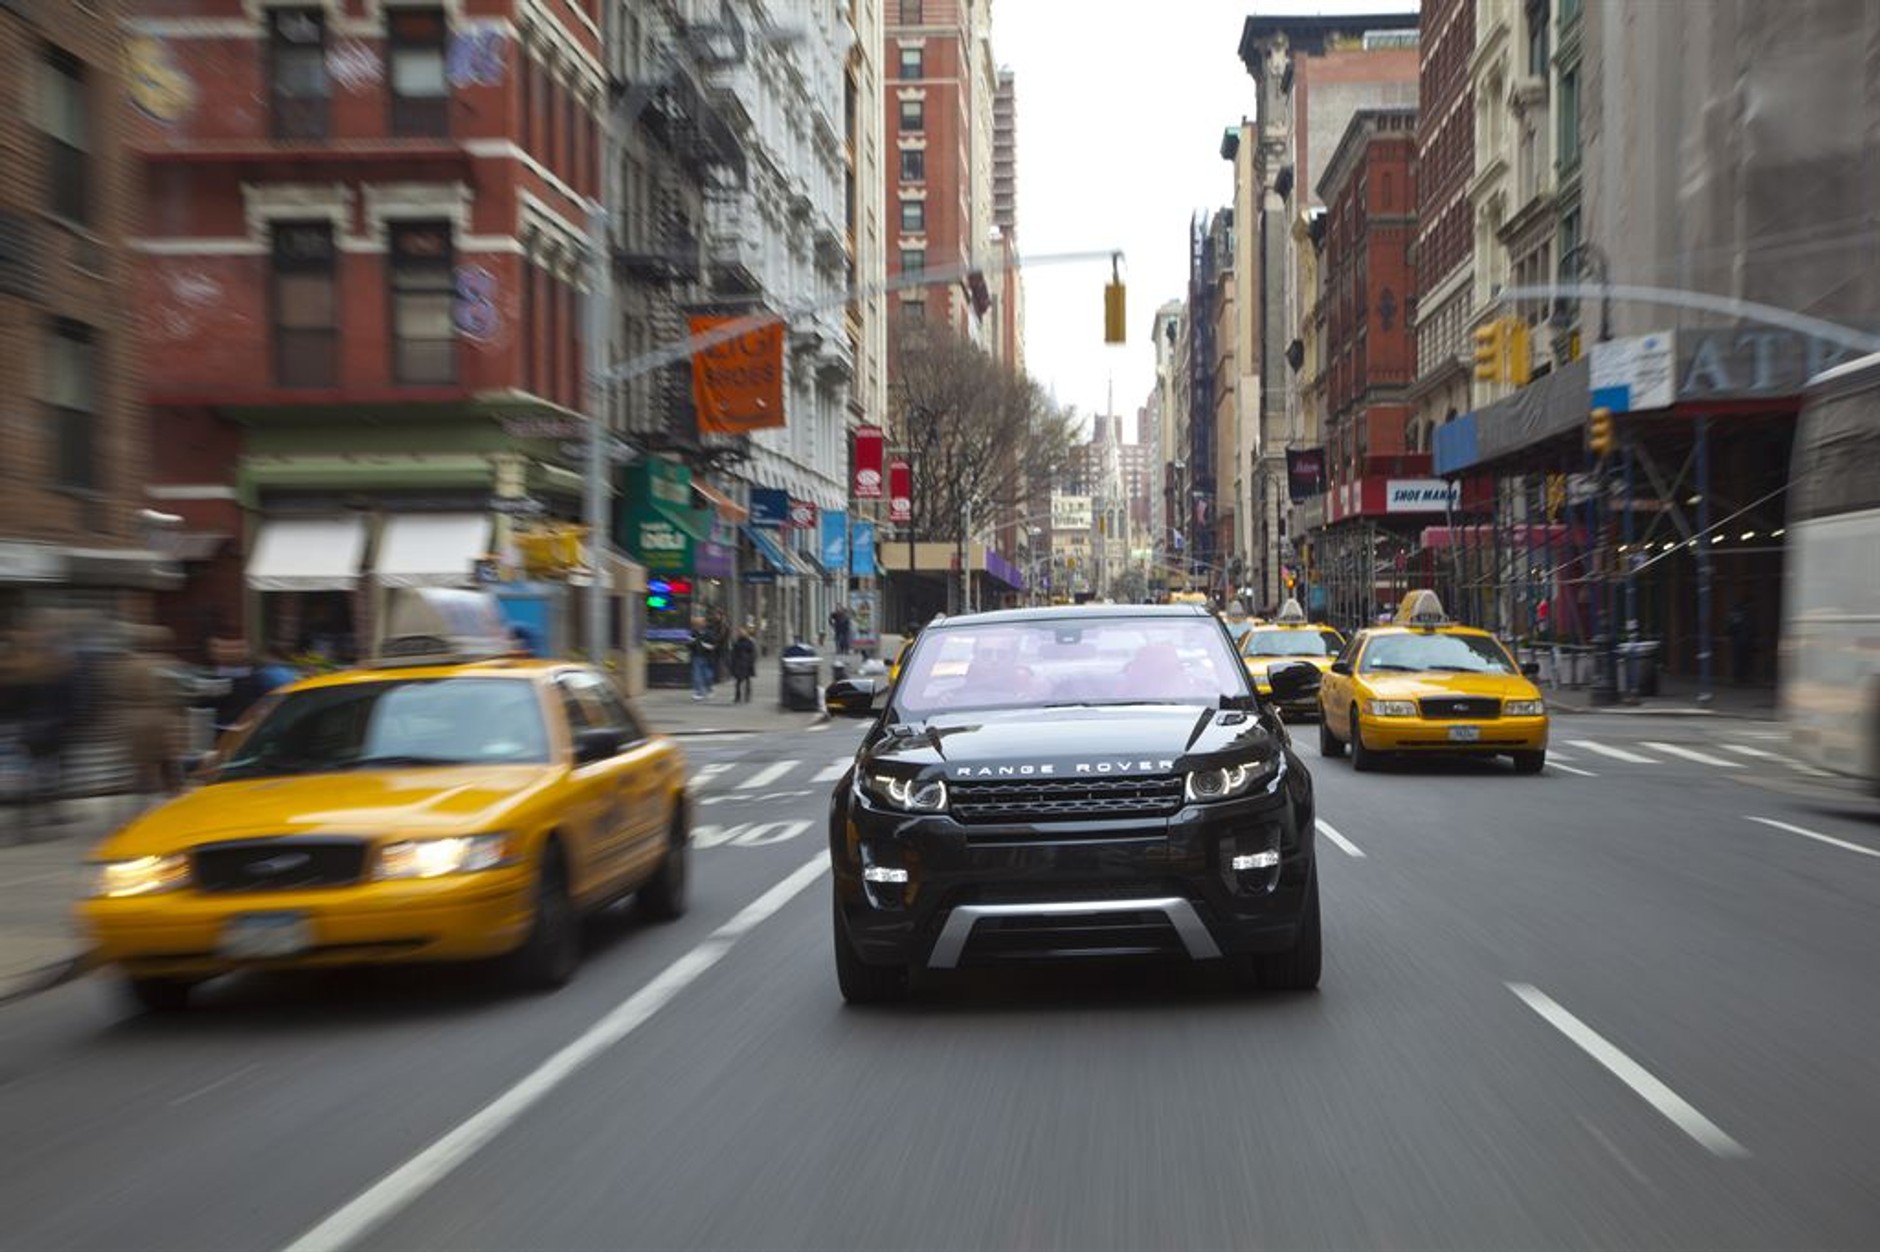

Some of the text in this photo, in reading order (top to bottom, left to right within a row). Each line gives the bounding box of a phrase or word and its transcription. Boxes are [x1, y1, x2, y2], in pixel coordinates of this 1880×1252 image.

[1393, 488, 1458, 503] SHOE MANA
[957, 760, 1174, 776] RANGE ROVER
